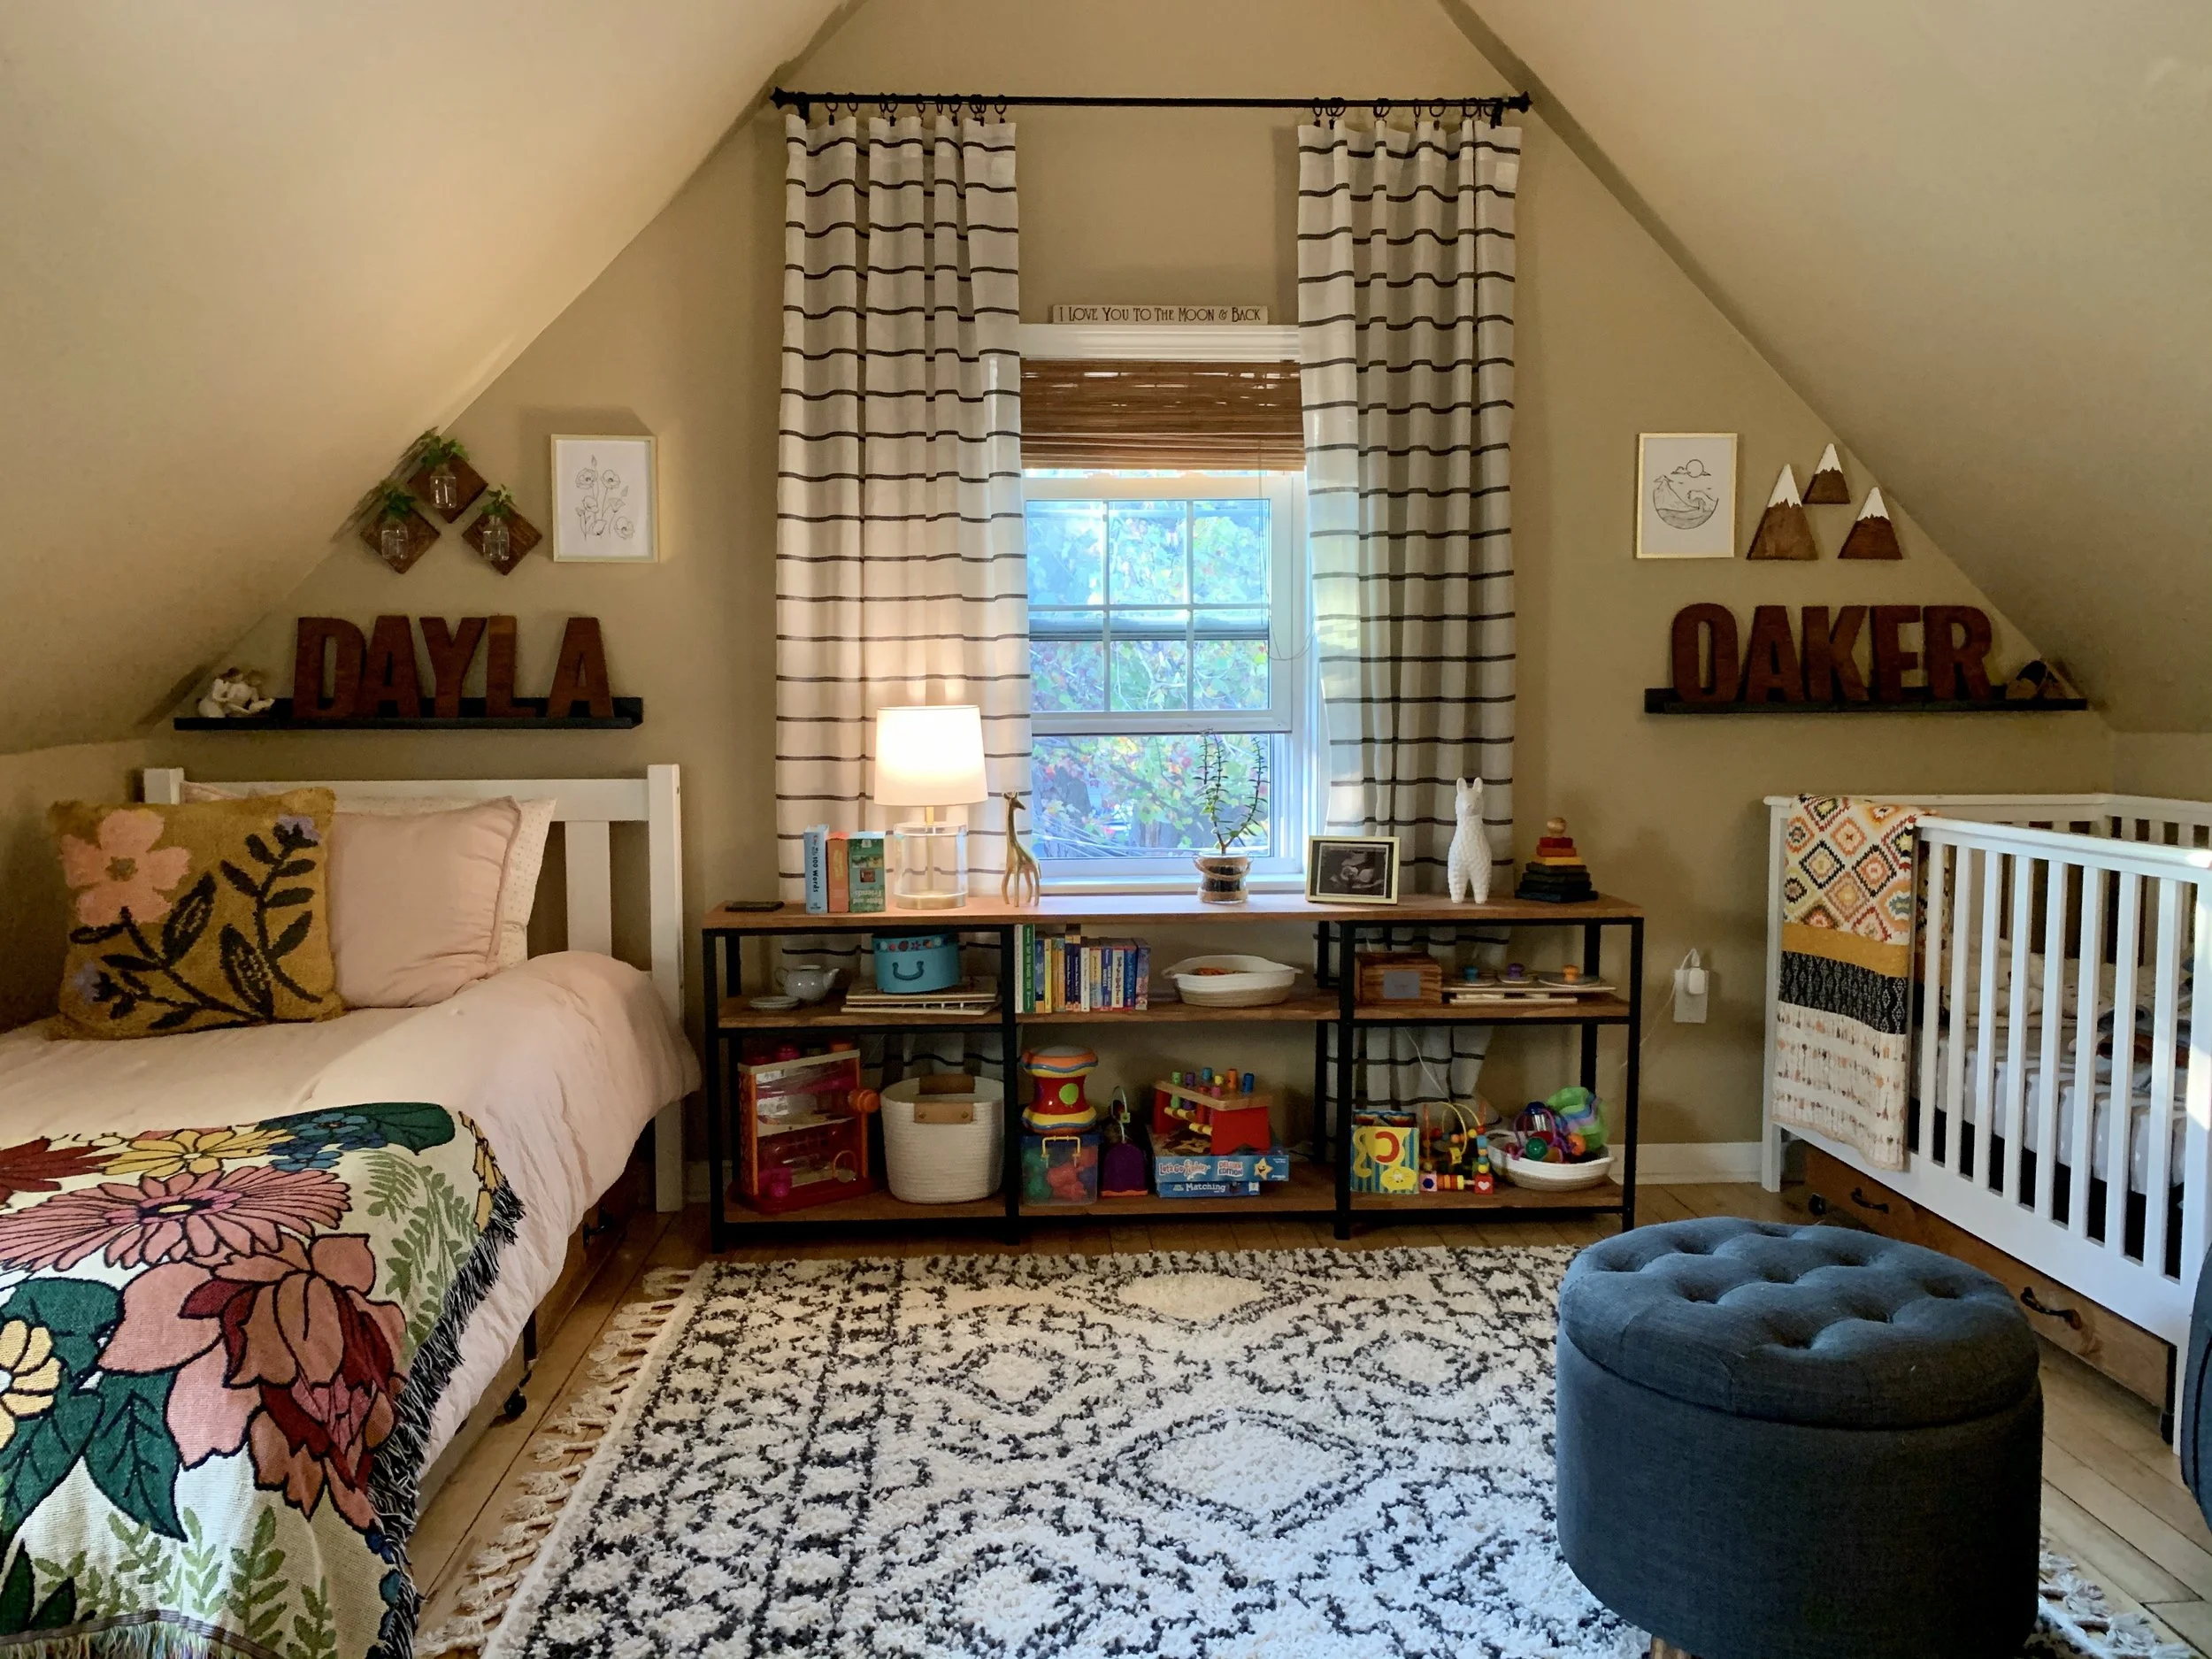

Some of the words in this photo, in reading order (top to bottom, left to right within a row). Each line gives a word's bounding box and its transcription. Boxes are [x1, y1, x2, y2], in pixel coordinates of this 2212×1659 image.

[1059, 306, 1064, 322] I
[1218, 309, 1229, 320] &
[291, 614, 615, 718] DAYLA
[1671, 602, 1993, 704] OAKER
[1186, 1182, 1226, 1193] Matching
